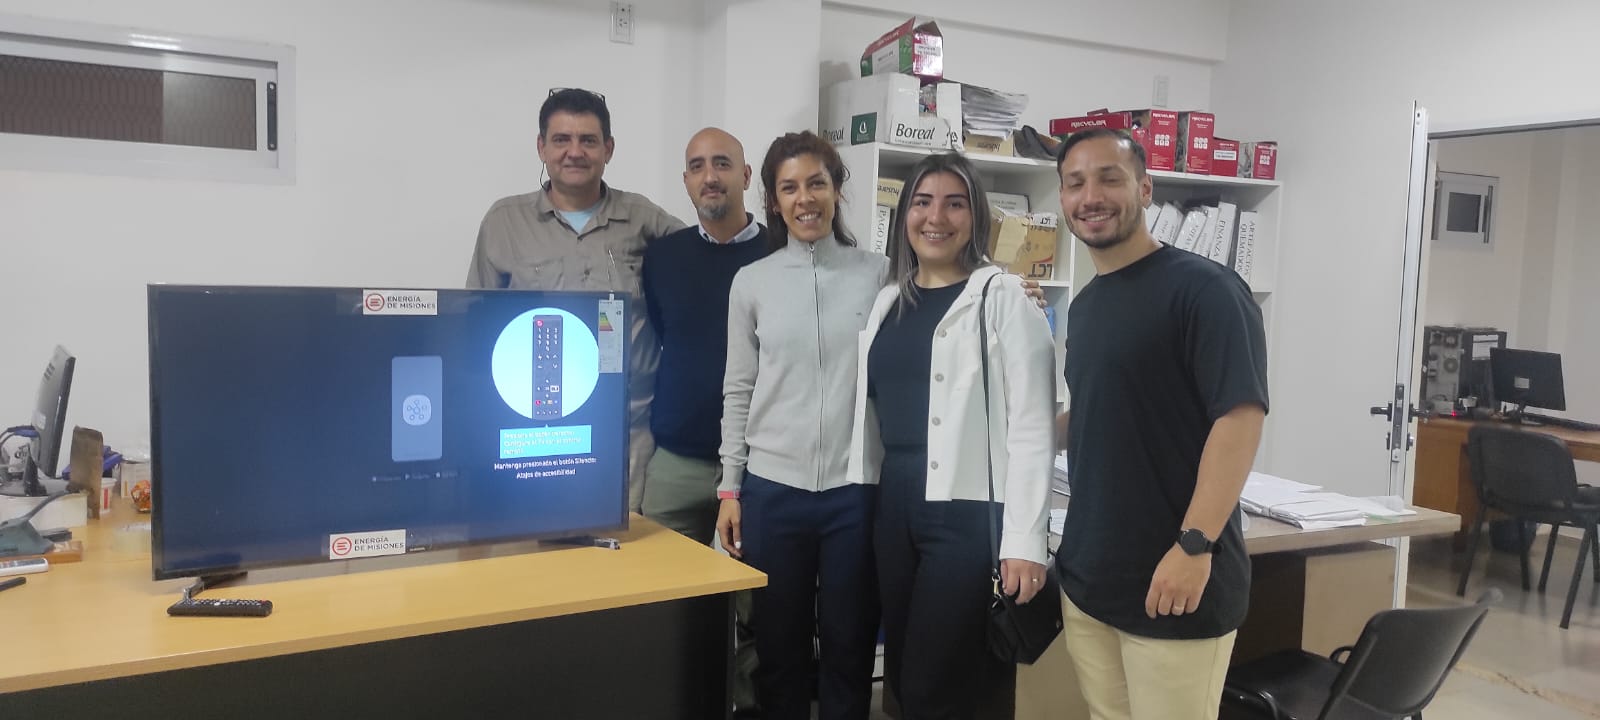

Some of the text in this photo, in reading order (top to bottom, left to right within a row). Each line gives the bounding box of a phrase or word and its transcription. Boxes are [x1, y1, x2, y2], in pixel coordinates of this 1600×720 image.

[895, 123, 936, 140] Boreal
[876, 210, 887, 237] PAGO
[494, 461, 522, 470] Mantenga
[522, 459, 553, 469] presionado
[516, 468, 576, 480] Atajos de accesibilidad
[367, 542, 404, 551] MISIONES
